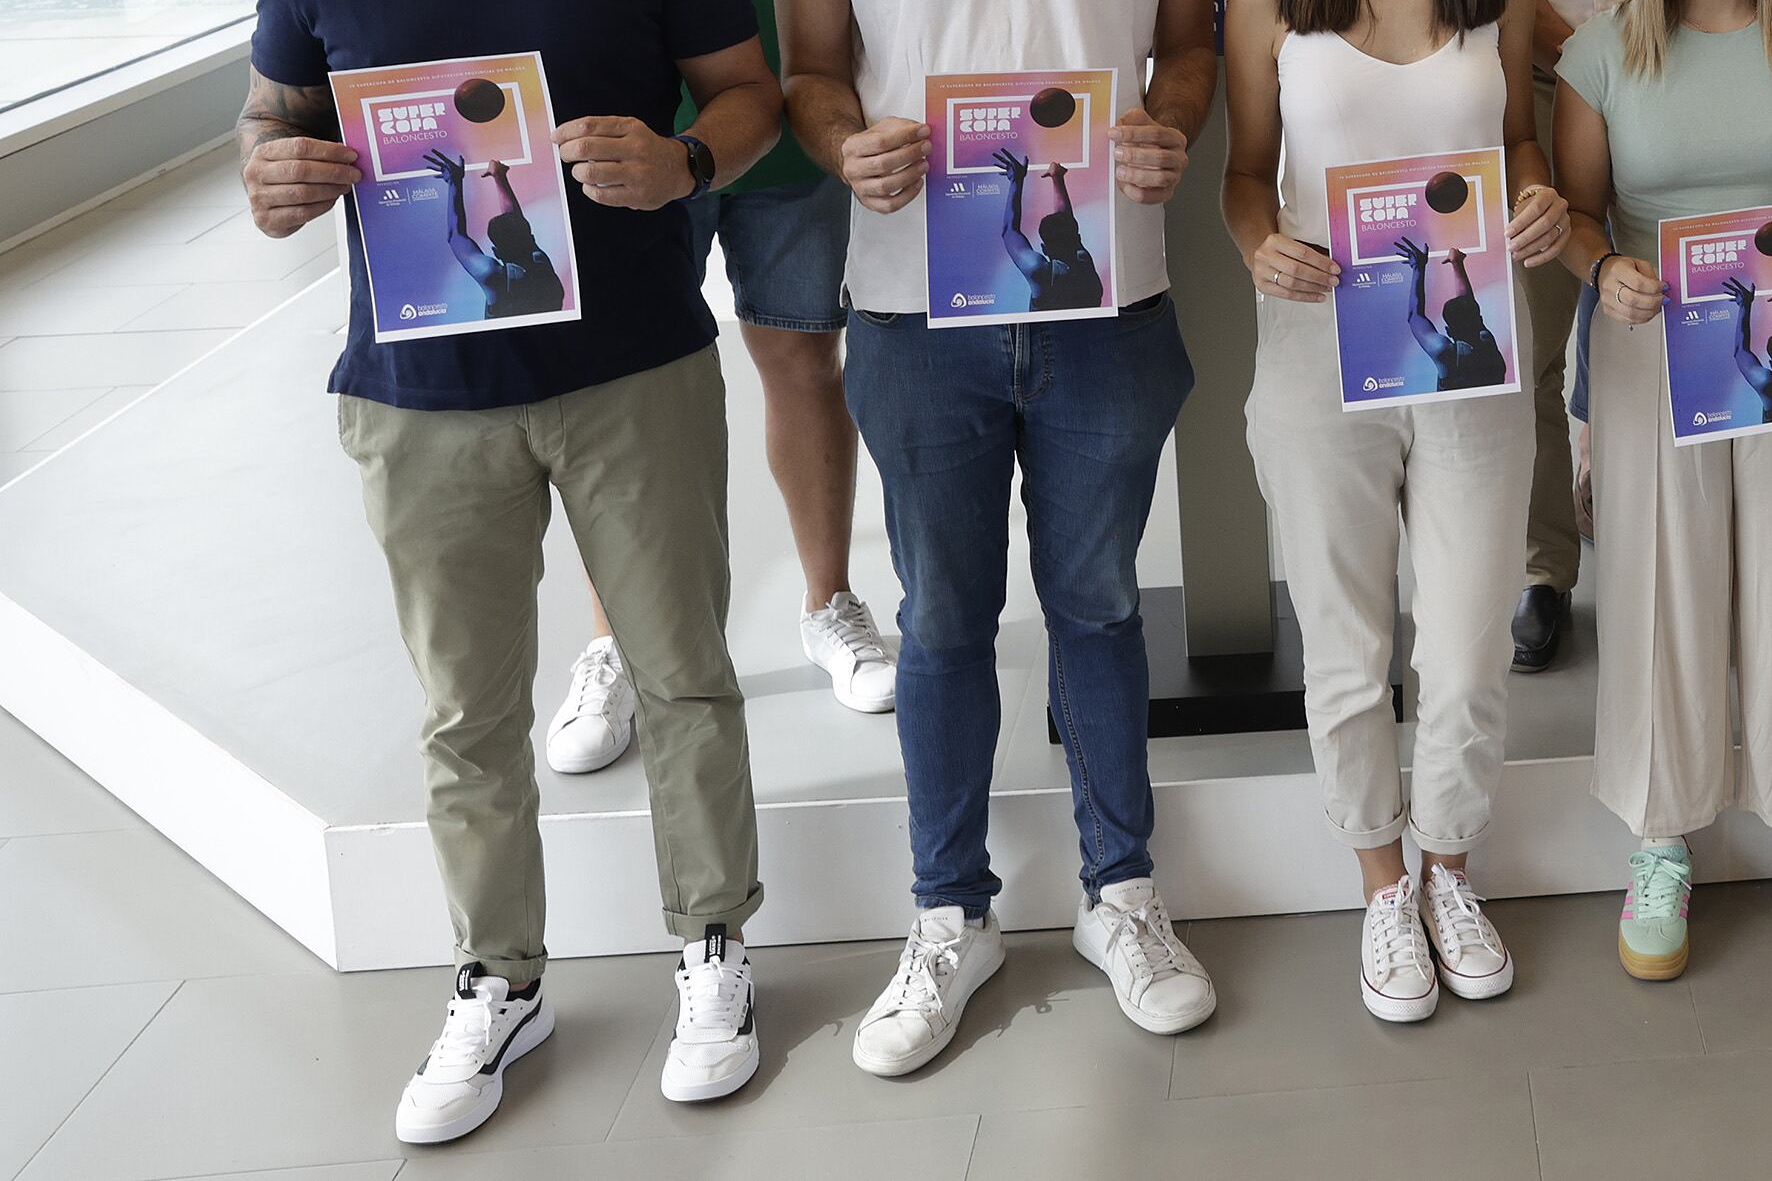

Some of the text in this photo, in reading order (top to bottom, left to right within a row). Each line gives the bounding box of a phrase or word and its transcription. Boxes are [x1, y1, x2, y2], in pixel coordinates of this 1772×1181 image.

[376, 102, 447, 123] SUPER
[380, 116, 438, 135] COPA
[959, 118, 1011, 132] COPA
[382, 130, 448, 145] BALONCESTO
[959, 131, 1018, 141] BALONCESTO
[1359, 193, 1417, 212] SUPER
[1360, 207, 1409, 223] COPA
[1361, 219, 1417, 232] BALONCESTO
[1691, 261, 1745, 274] BALONCESTO
